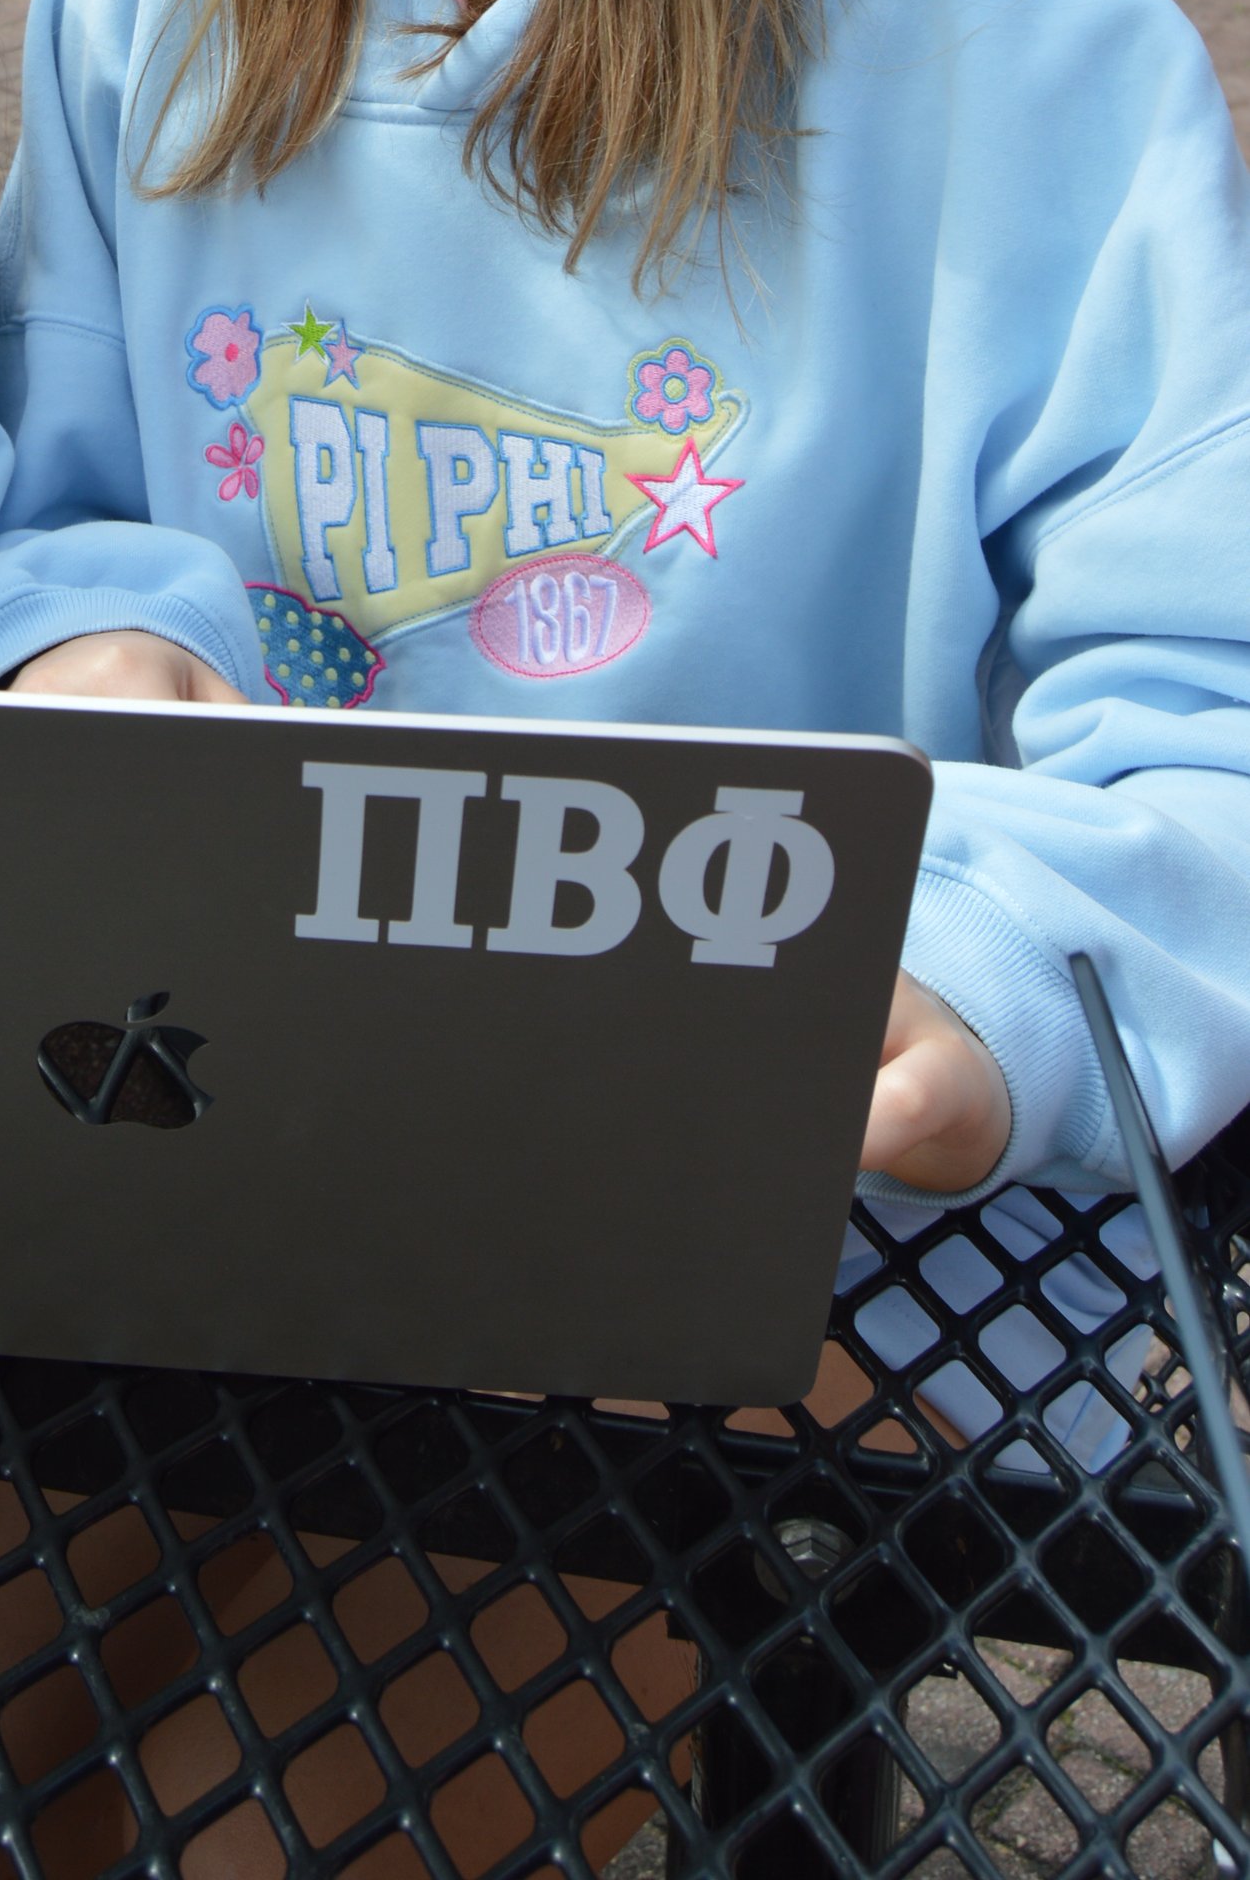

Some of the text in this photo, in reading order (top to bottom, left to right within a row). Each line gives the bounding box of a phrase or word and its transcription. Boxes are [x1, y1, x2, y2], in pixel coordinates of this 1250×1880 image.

[289, 395, 613, 603] PI PHI
[503, 572, 618, 666] 1867
